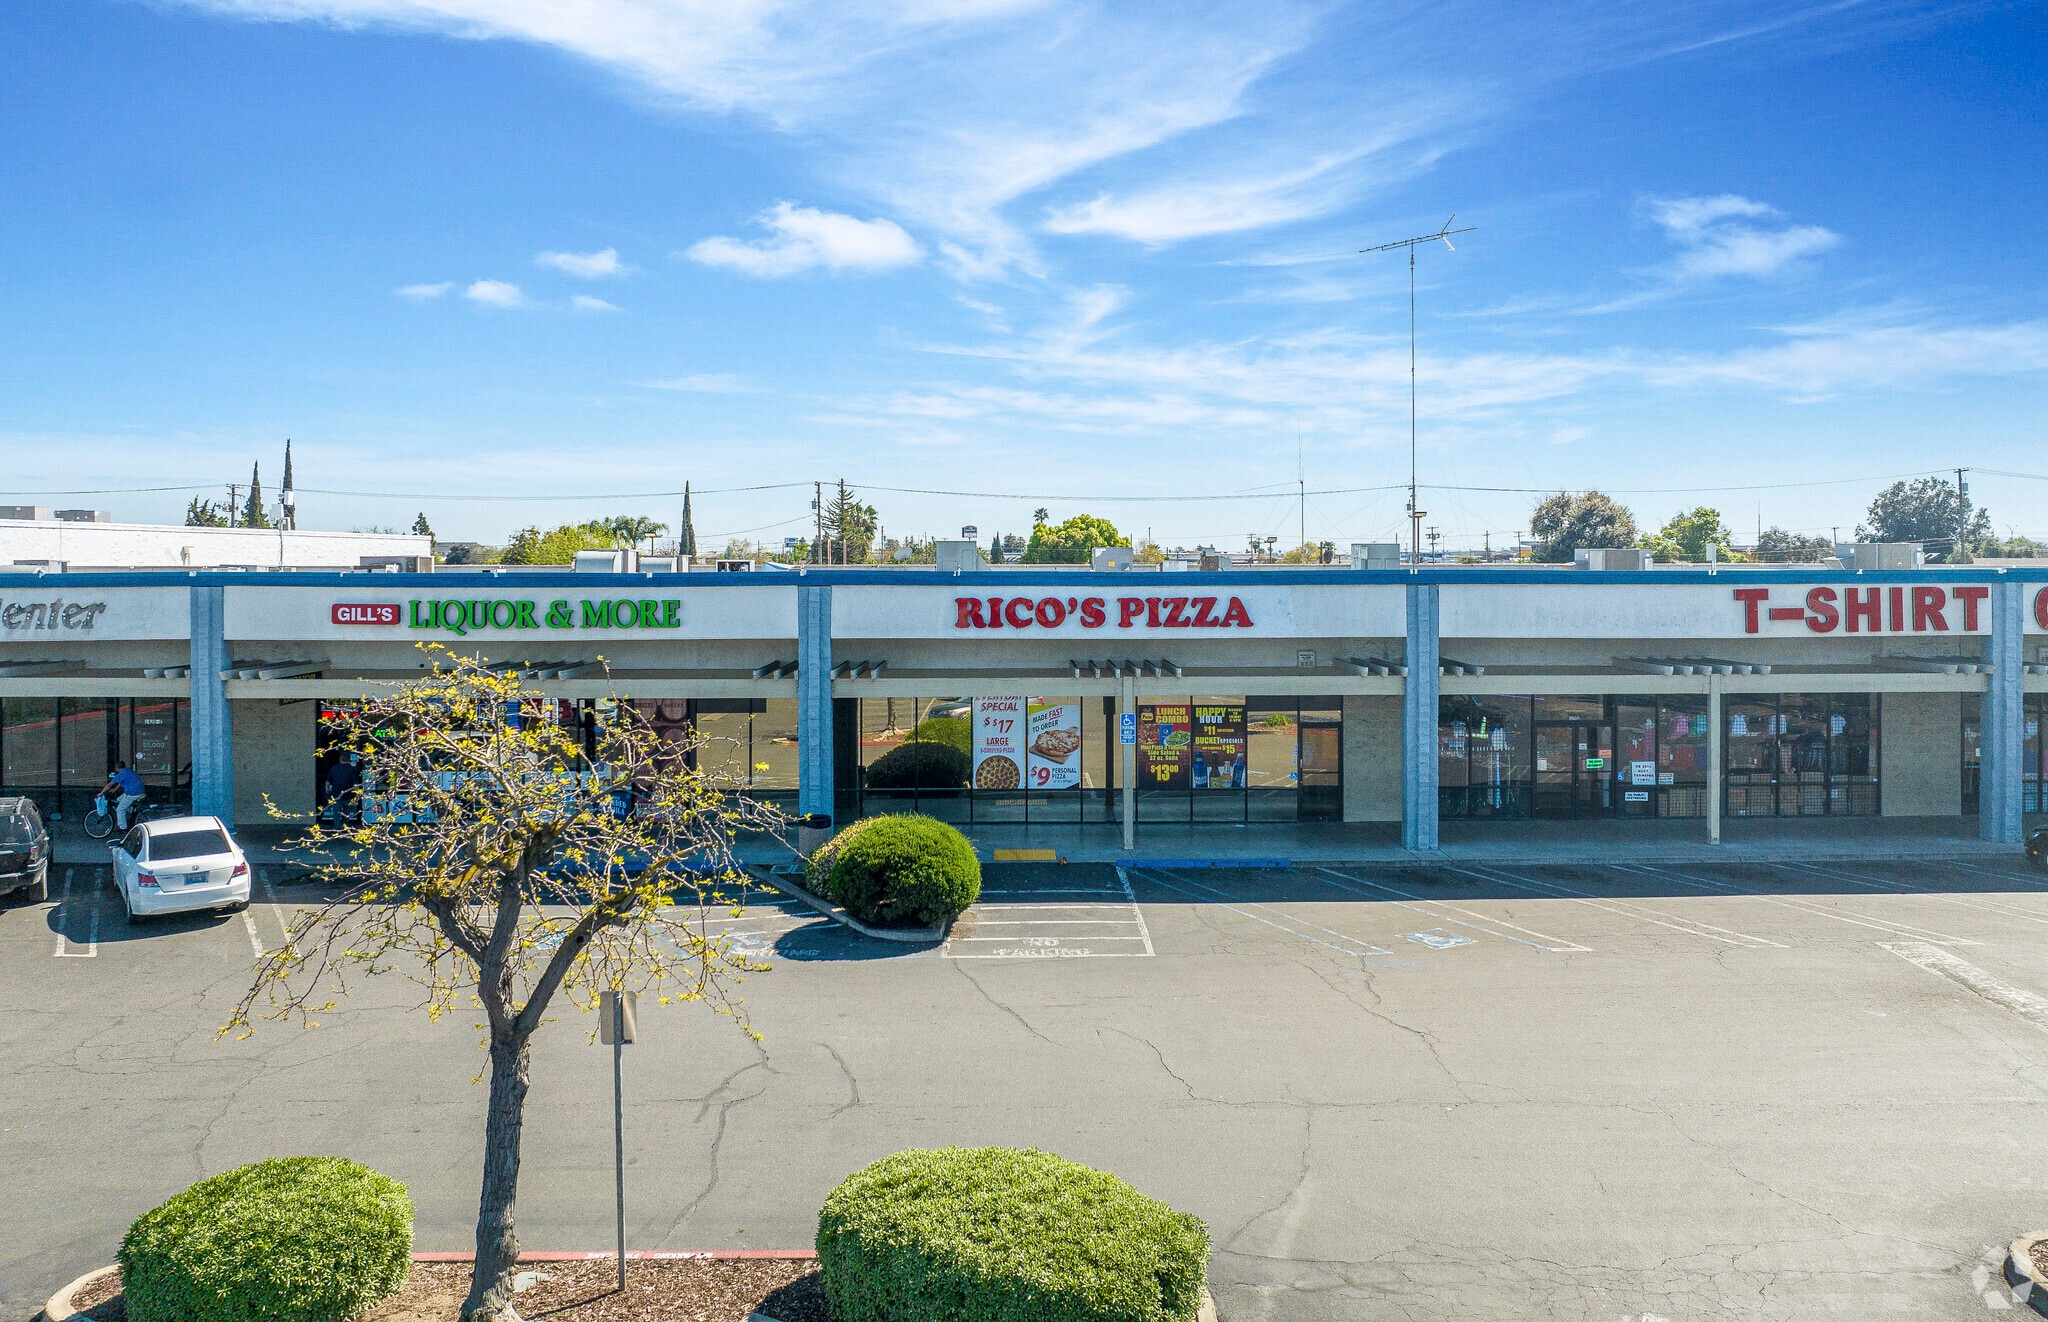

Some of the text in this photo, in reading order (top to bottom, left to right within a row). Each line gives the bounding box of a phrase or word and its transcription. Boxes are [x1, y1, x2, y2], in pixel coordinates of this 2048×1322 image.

[0, 598, 107, 629] enter
[954, 596, 1254, 629] RICO'S PIZZA
[1734, 586, 1989, 633] T-SHIRT
[337, 599, 680, 636] GILL'S LIQUOR & MORE
[981, 702, 1018, 712] SPECIAL
[1156, 707, 1186, 715] LUNCH
[1195, 707, 1226, 717] HAPPY
[1032, 707, 1063, 723] MADE FAST
[1155, 715, 1188, 723] COMBO
[1032, 720, 1059, 733] TO ORDER
[1204, 726, 1216, 735] $11
[986, 737, 1009, 745] LARGE
[1222, 745, 1236, 754] $15
[1031, 765, 1051, 787] $9
